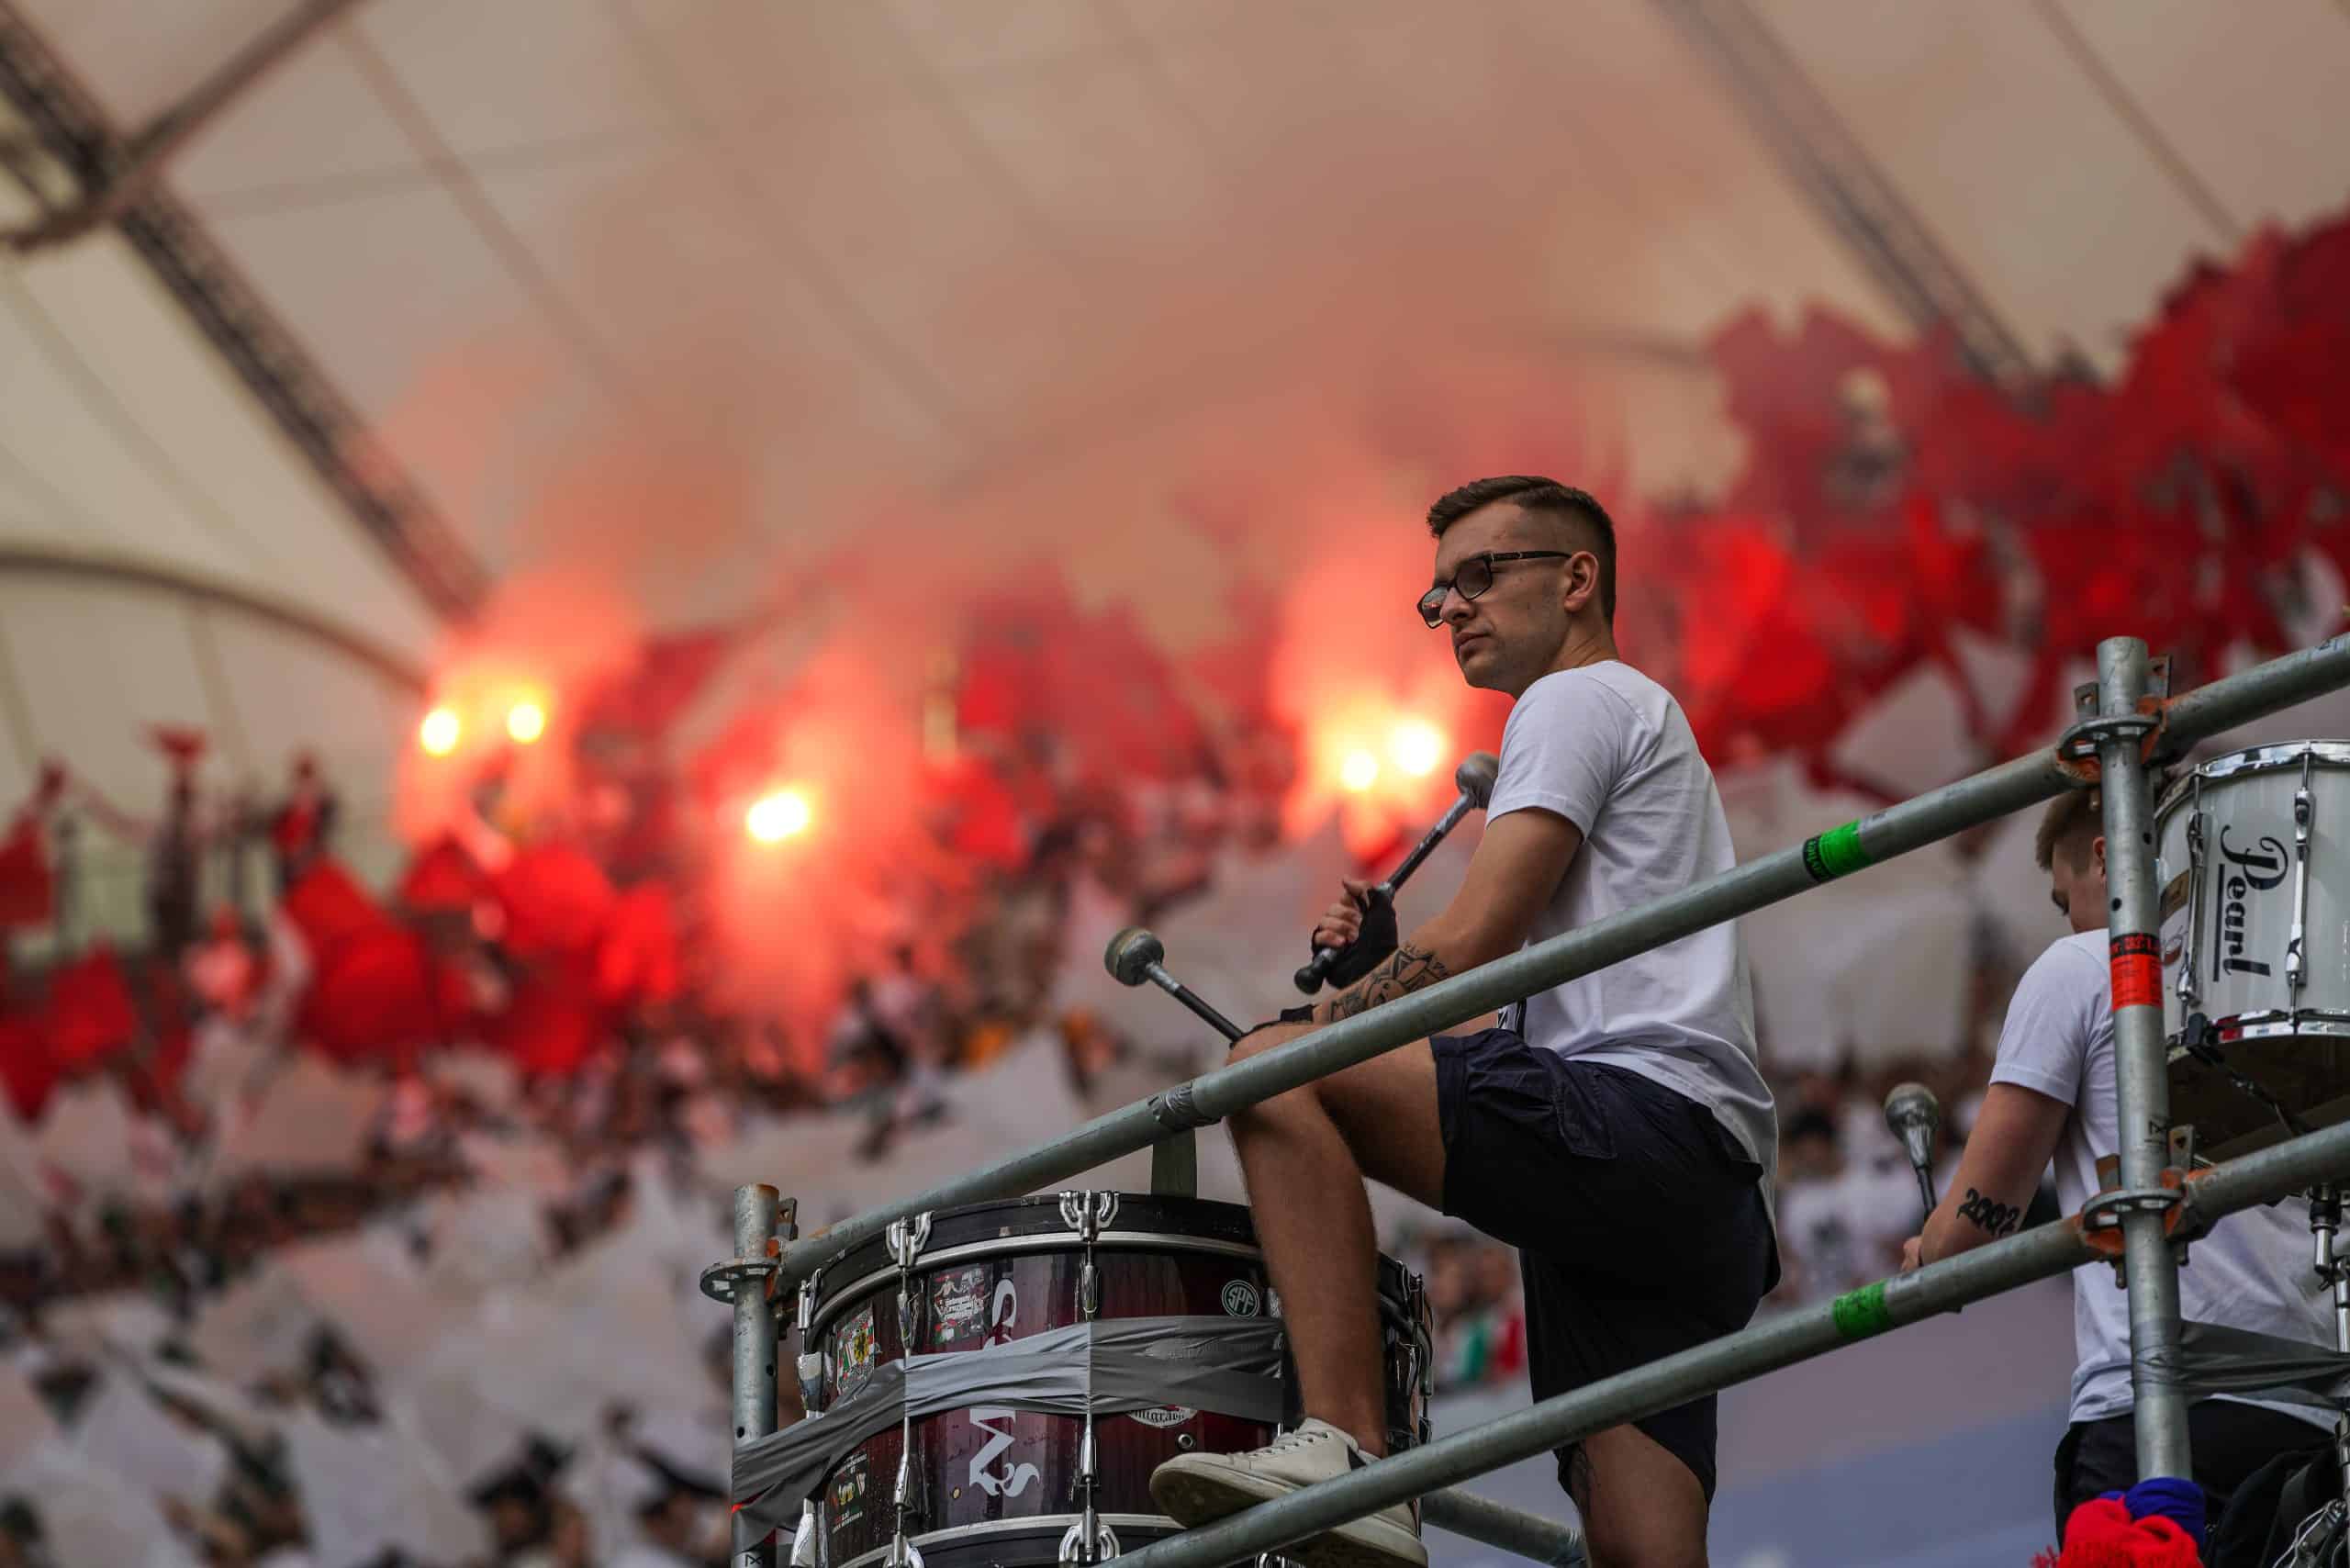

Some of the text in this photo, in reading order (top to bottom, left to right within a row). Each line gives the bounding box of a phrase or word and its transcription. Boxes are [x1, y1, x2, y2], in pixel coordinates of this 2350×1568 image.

[2220, 824, 2288, 978] Pearl
[1956, 1187, 2021, 1238] 2002
[1228, 1285, 1254, 1313] SPF
